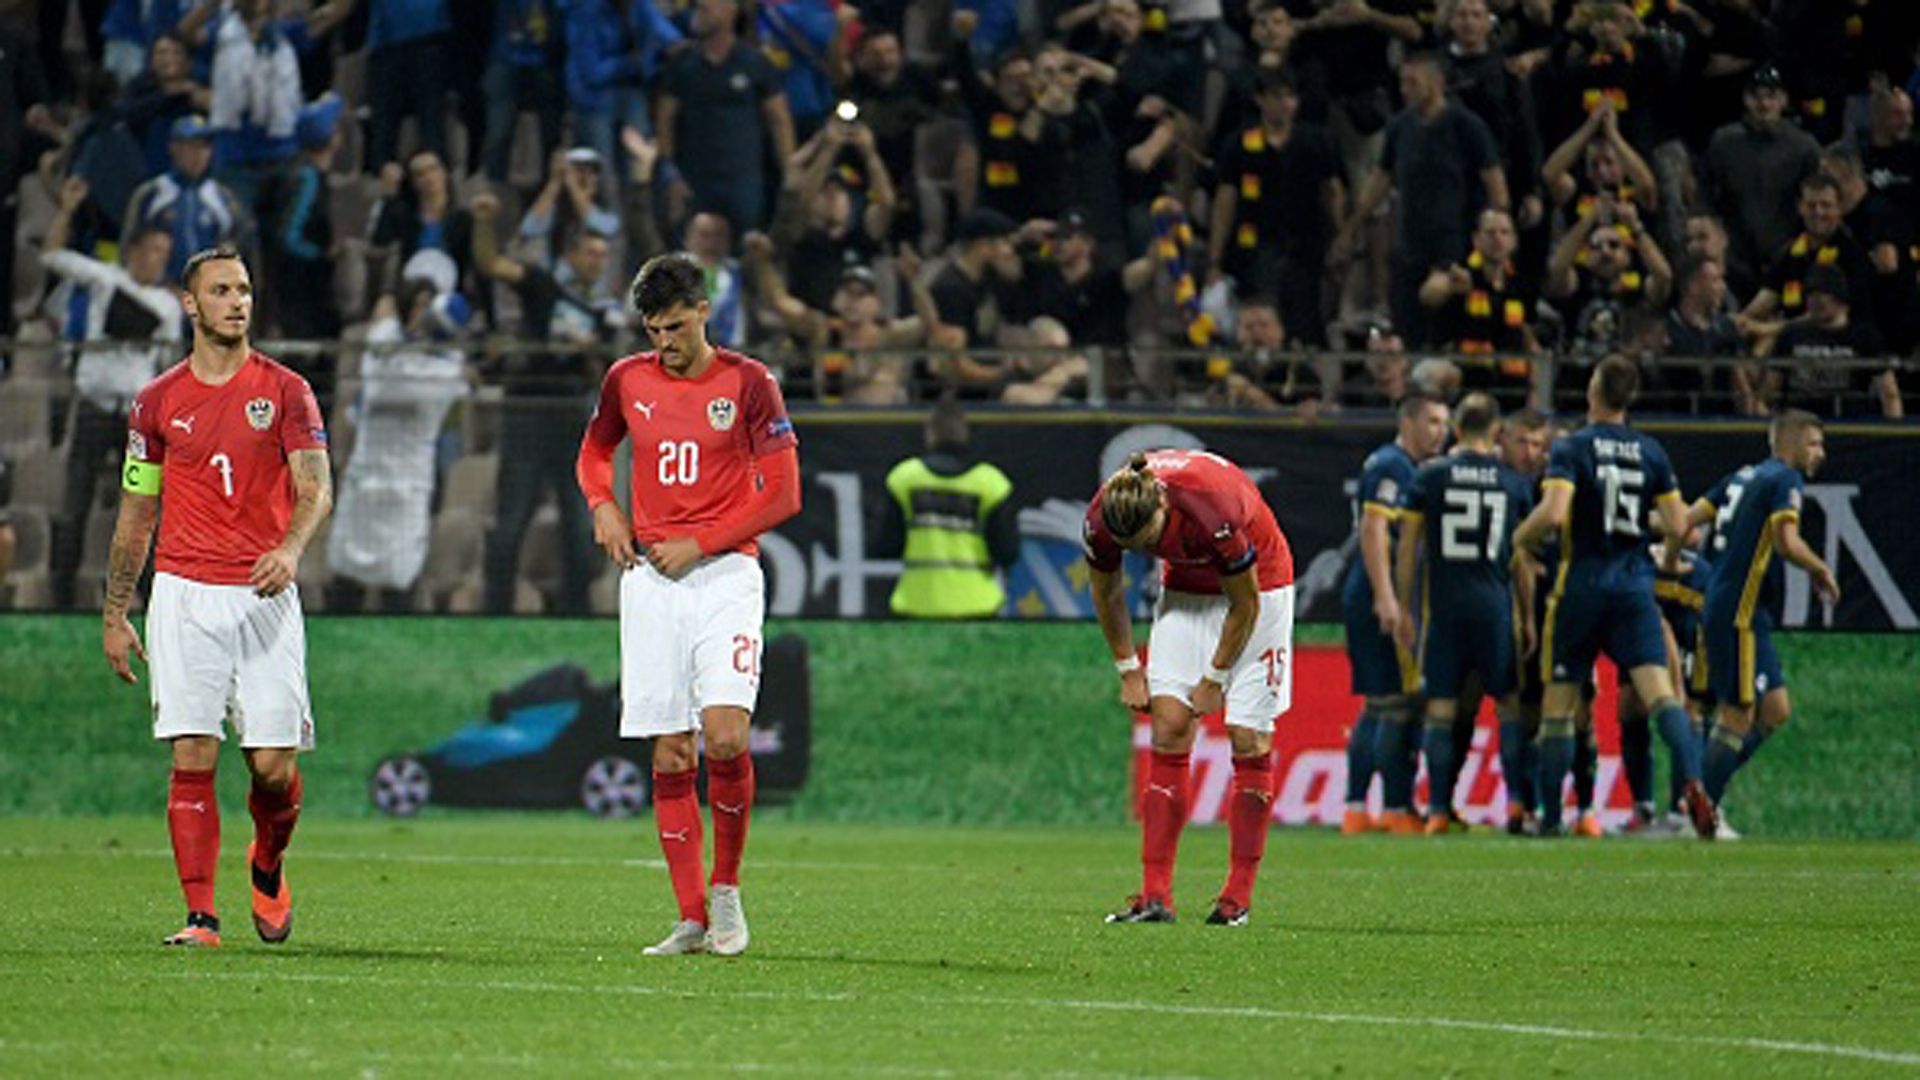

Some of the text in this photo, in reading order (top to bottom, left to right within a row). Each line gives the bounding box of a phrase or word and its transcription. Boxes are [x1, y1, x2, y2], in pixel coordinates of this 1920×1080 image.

[126, 465, 141, 486] C
[658, 440, 699, 485] 20
[1441, 488, 1507, 562] 21
[1597, 465, 1644, 535] 15
